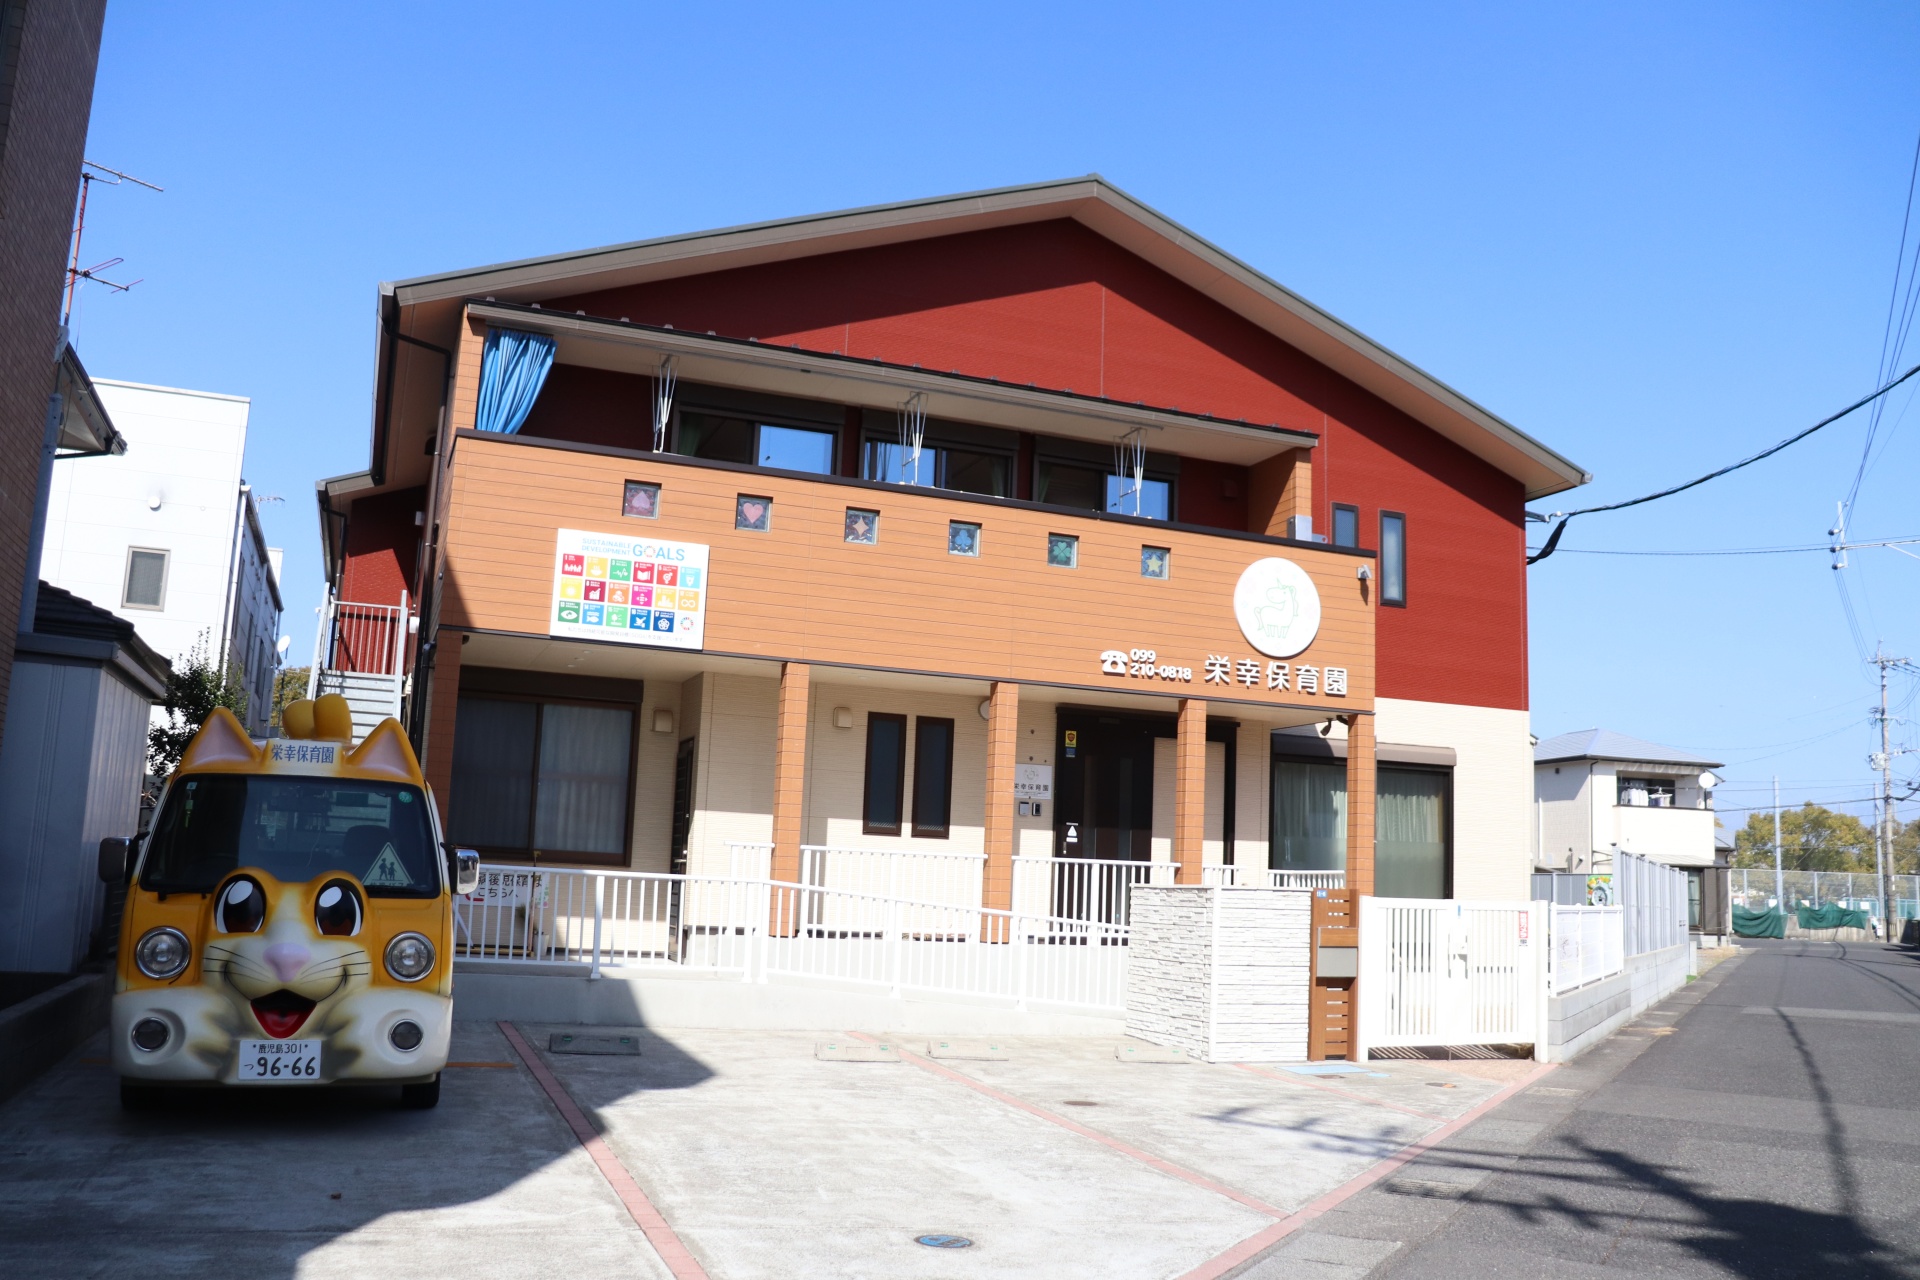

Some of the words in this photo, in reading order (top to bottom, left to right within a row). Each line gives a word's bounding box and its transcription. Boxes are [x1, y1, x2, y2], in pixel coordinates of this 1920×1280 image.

[581, 545, 631, 556] DEVELOPMENT
[582, 537, 631, 549] SUSTAINABLE
[632, 543, 685, 562] GOALS
[1130, 648, 1156, 662] 099
[1130, 663, 1192, 681] 210-0818
[1203, 654, 1348, 695] 栄幸保育園
[271, 743, 334, 764] 栄幸保育園
[1014, 782, 1049, 792] 栄幸保育園
[244, 1063, 254, 1071] つ
[257, 1056, 316, 1077] 96-66
